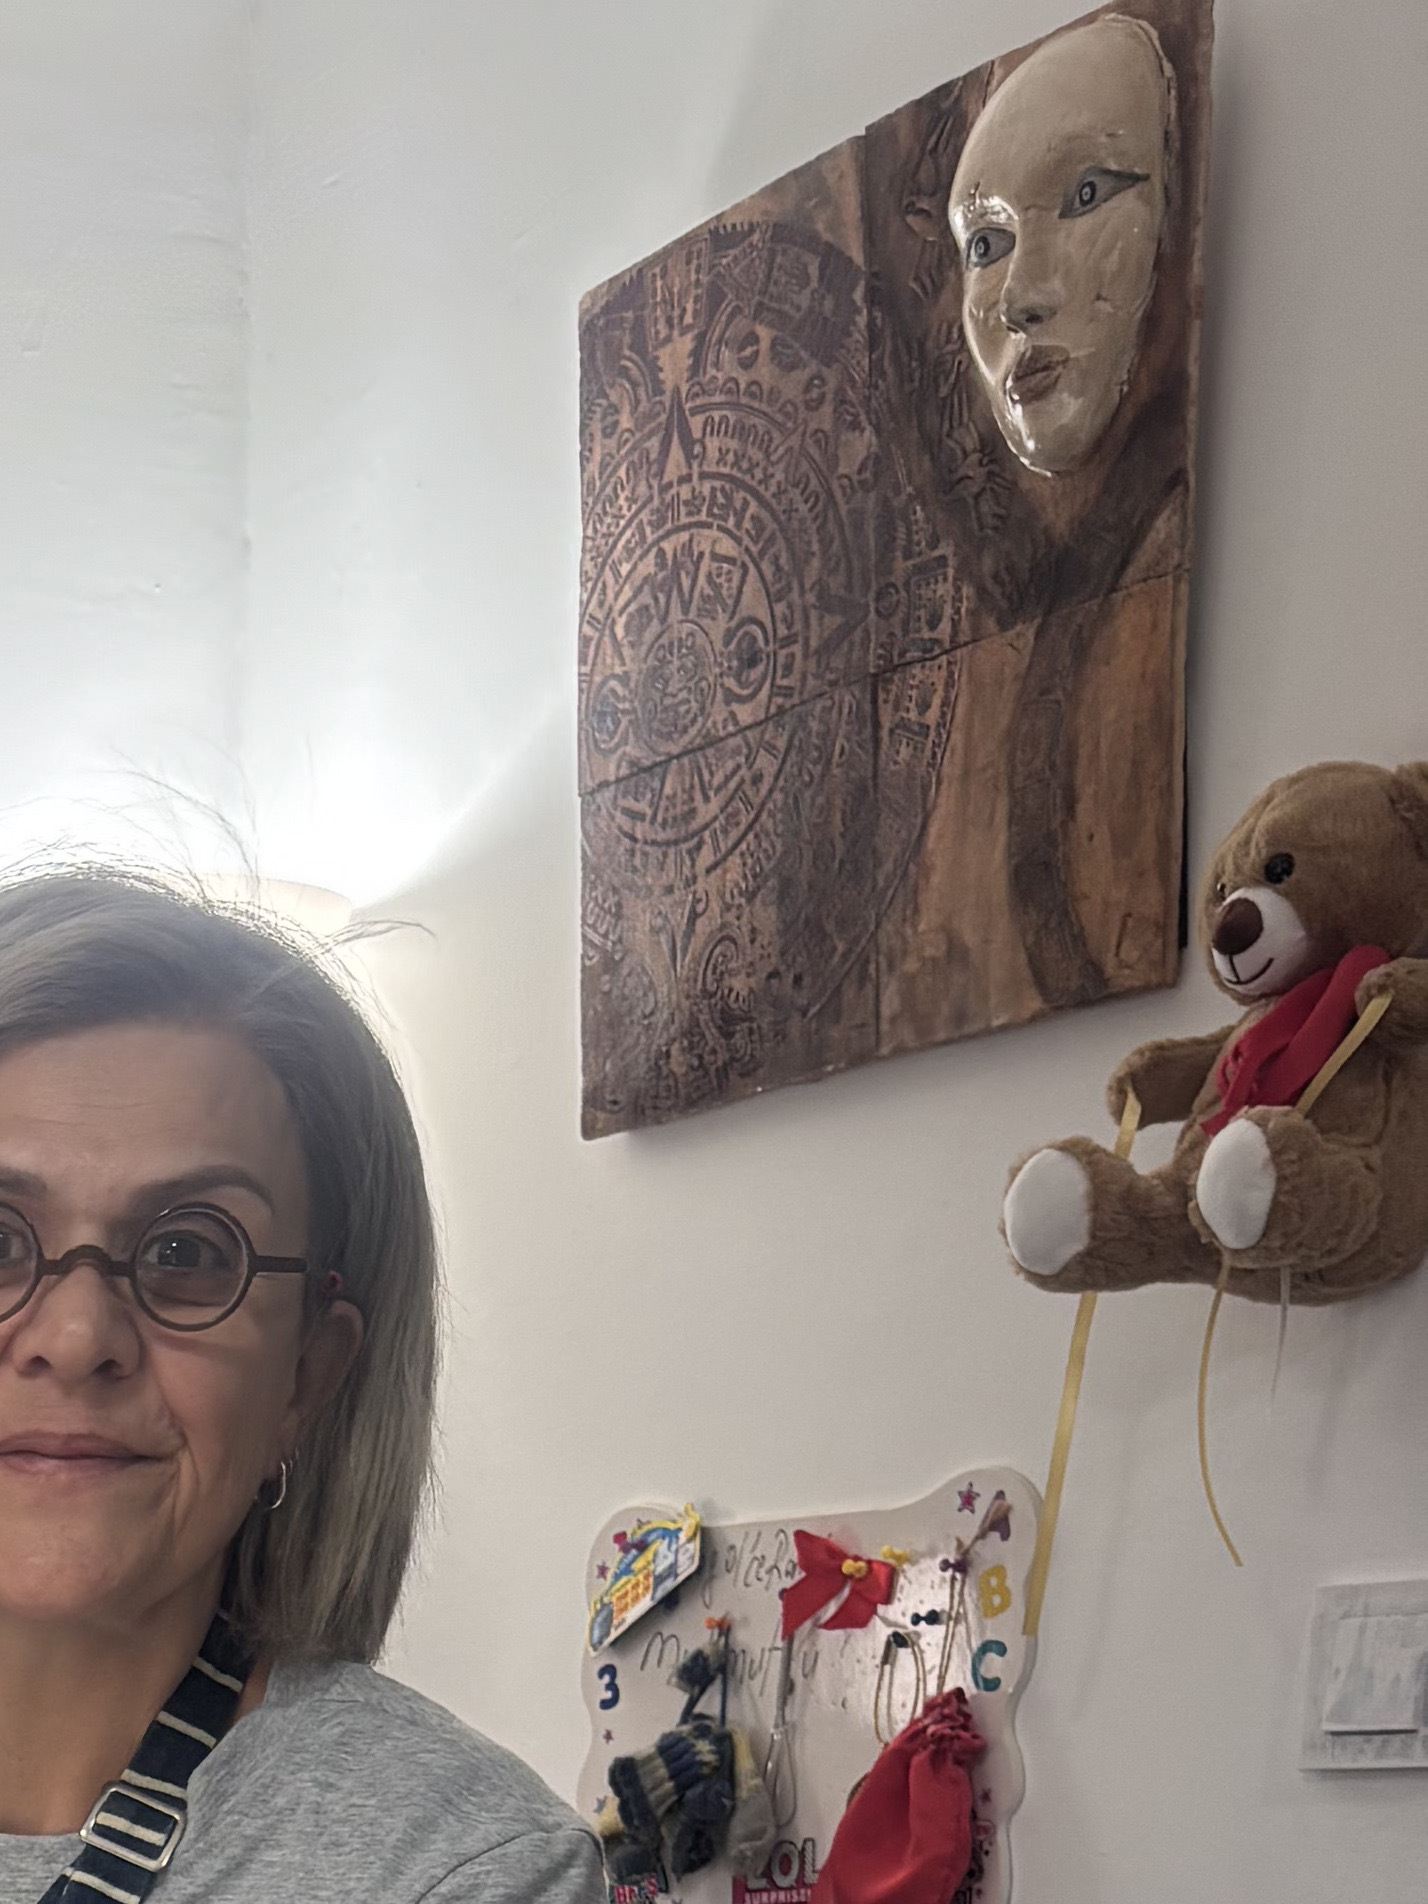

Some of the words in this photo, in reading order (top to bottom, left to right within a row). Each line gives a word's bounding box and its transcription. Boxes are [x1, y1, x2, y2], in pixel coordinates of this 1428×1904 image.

[979, 1564, 1012, 1619] B
[597, 1663, 621, 1710] 3
[970, 1639, 1007, 1692] C
